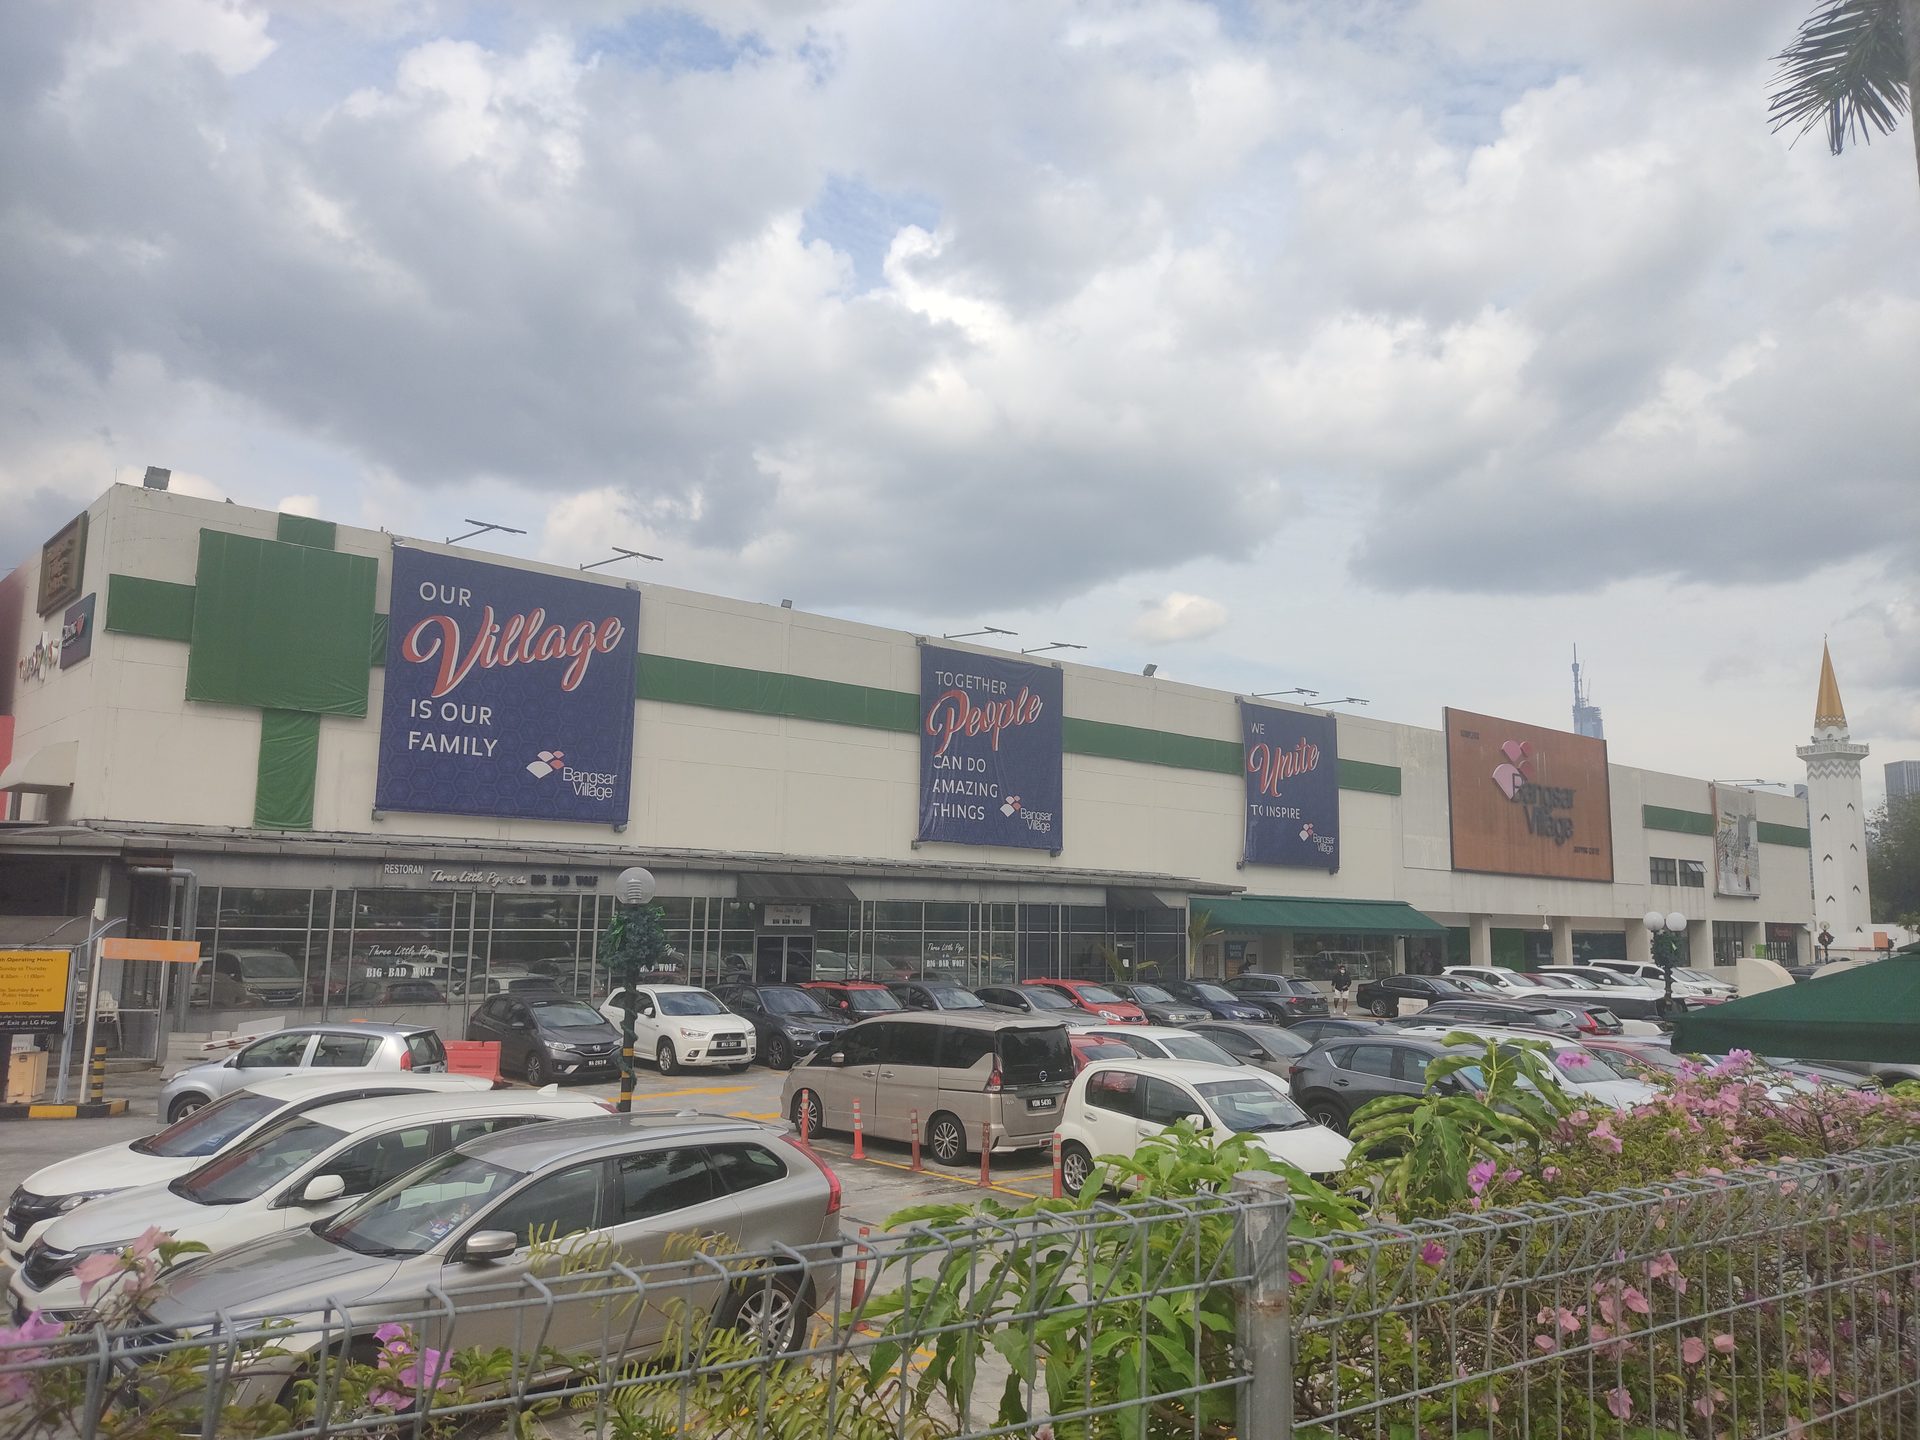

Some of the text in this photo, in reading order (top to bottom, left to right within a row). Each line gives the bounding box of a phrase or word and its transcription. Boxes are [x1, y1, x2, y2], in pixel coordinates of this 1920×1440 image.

[419, 581, 472, 608] OUR
[402, 604, 626, 699] Village
[935, 670, 1007, 695] TOGETHER
[410, 698, 493, 726] IS OUR
[926, 685, 1044, 756] People
[1250, 723, 1265, 735] WE
[408, 731, 498, 758] FAMILY
[933, 754, 987, 773] CAN DO
[1247, 736, 1320, 798] Unite
[562, 767, 618, 786] Bangsar
[572, 781, 613, 802] Village
[932, 778, 999, 799] AMAZING
[1512, 773, 1577, 817] Bangsar
[933, 802, 985, 820] THINGS
[1020, 807, 1053, 823] Bangsar
[1250, 804, 1300, 820] TO INSPIRE
[1026, 819, 1051, 834] Village
[1522, 805, 1575, 846] Village
[384, 863, 424, 875] RESTORAN
[429, 869, 457, 883] Three
[458, 870, 484, 884] Little
[507, 875, 515, 885] &
[530, 874, 547, 886] BIG
[551, 874, 571, 887] BAD
[575, 875, 599, 887] WOLF
[368, 944, 392, 956] Three
[394, 944, 416, 956] Little
[927, 942, 941, 952] Three
[941, 942, 954, 952] Little
[411, 967, 436, 979] WOLF
[658, 963, 677, 973] WOLF
